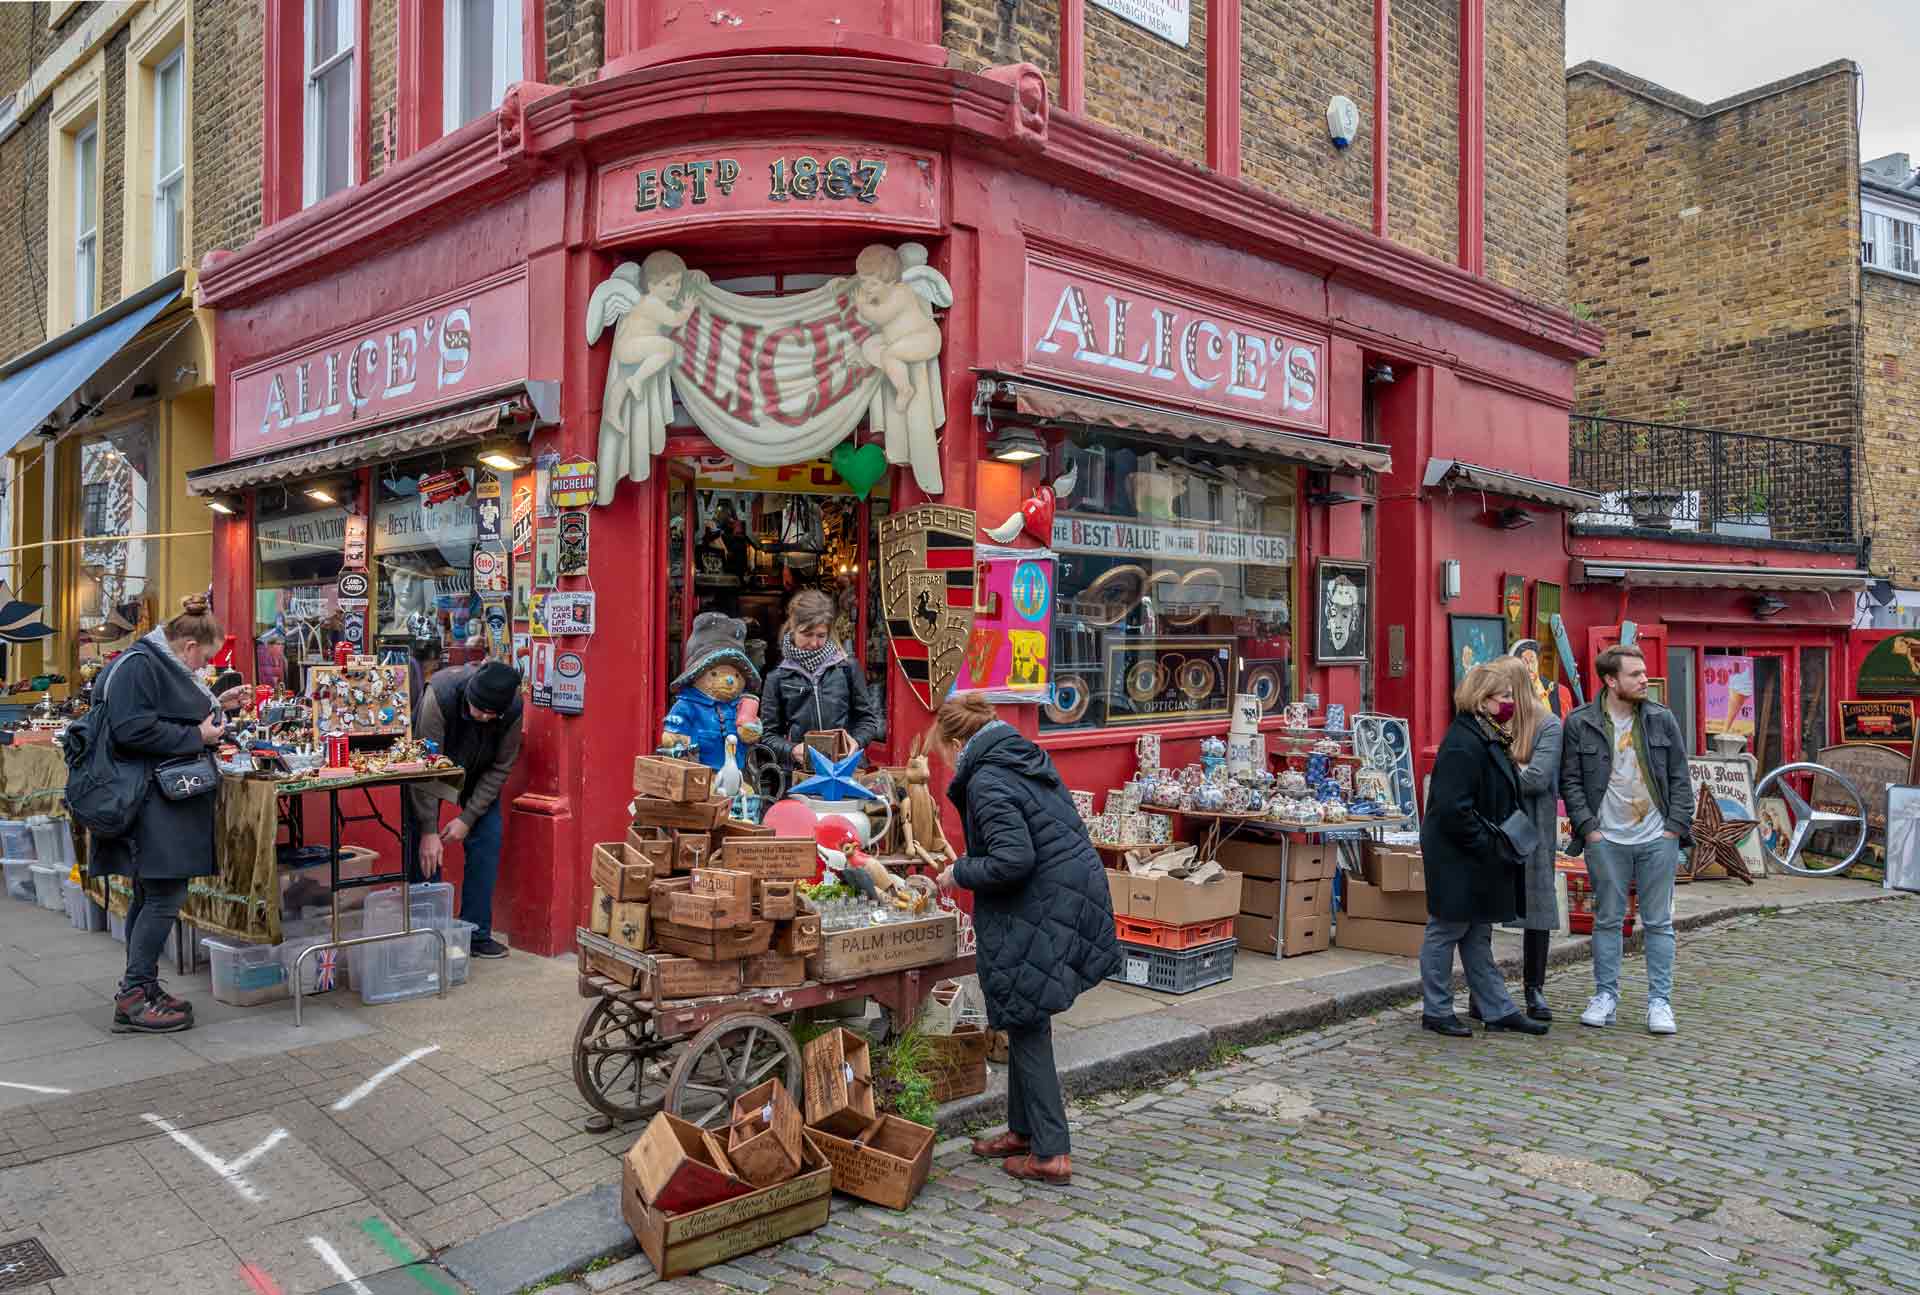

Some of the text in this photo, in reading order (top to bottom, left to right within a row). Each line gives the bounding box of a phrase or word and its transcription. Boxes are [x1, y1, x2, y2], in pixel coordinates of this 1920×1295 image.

[768, 156, 888, 205] 1887
[1035, 285, 1318, 412] ALICE'S
[259, 300, 472, 433] ALICE'S
[552, 477, 594, 491] MICHELIN
[388, 513, 408, 536] BEST
[411, 509, 438, 535] VALUE
[513, 511, 532, 541] GTX
[881, 509, 974, 537] PORSCHE
[1053, 521, 1285, 560] HE BEST VALUE IN THE BRITISH ISLES
[909, 574, 943, 586] STUTTGART
[552, 625, 591, 633] INSURANCE
[1143, 699, 1199, 713] OPTICIANS
[1846, 703, 1912, 716] LONDON TOURS
[842, 924, 945, 953] PALM HOUSE
